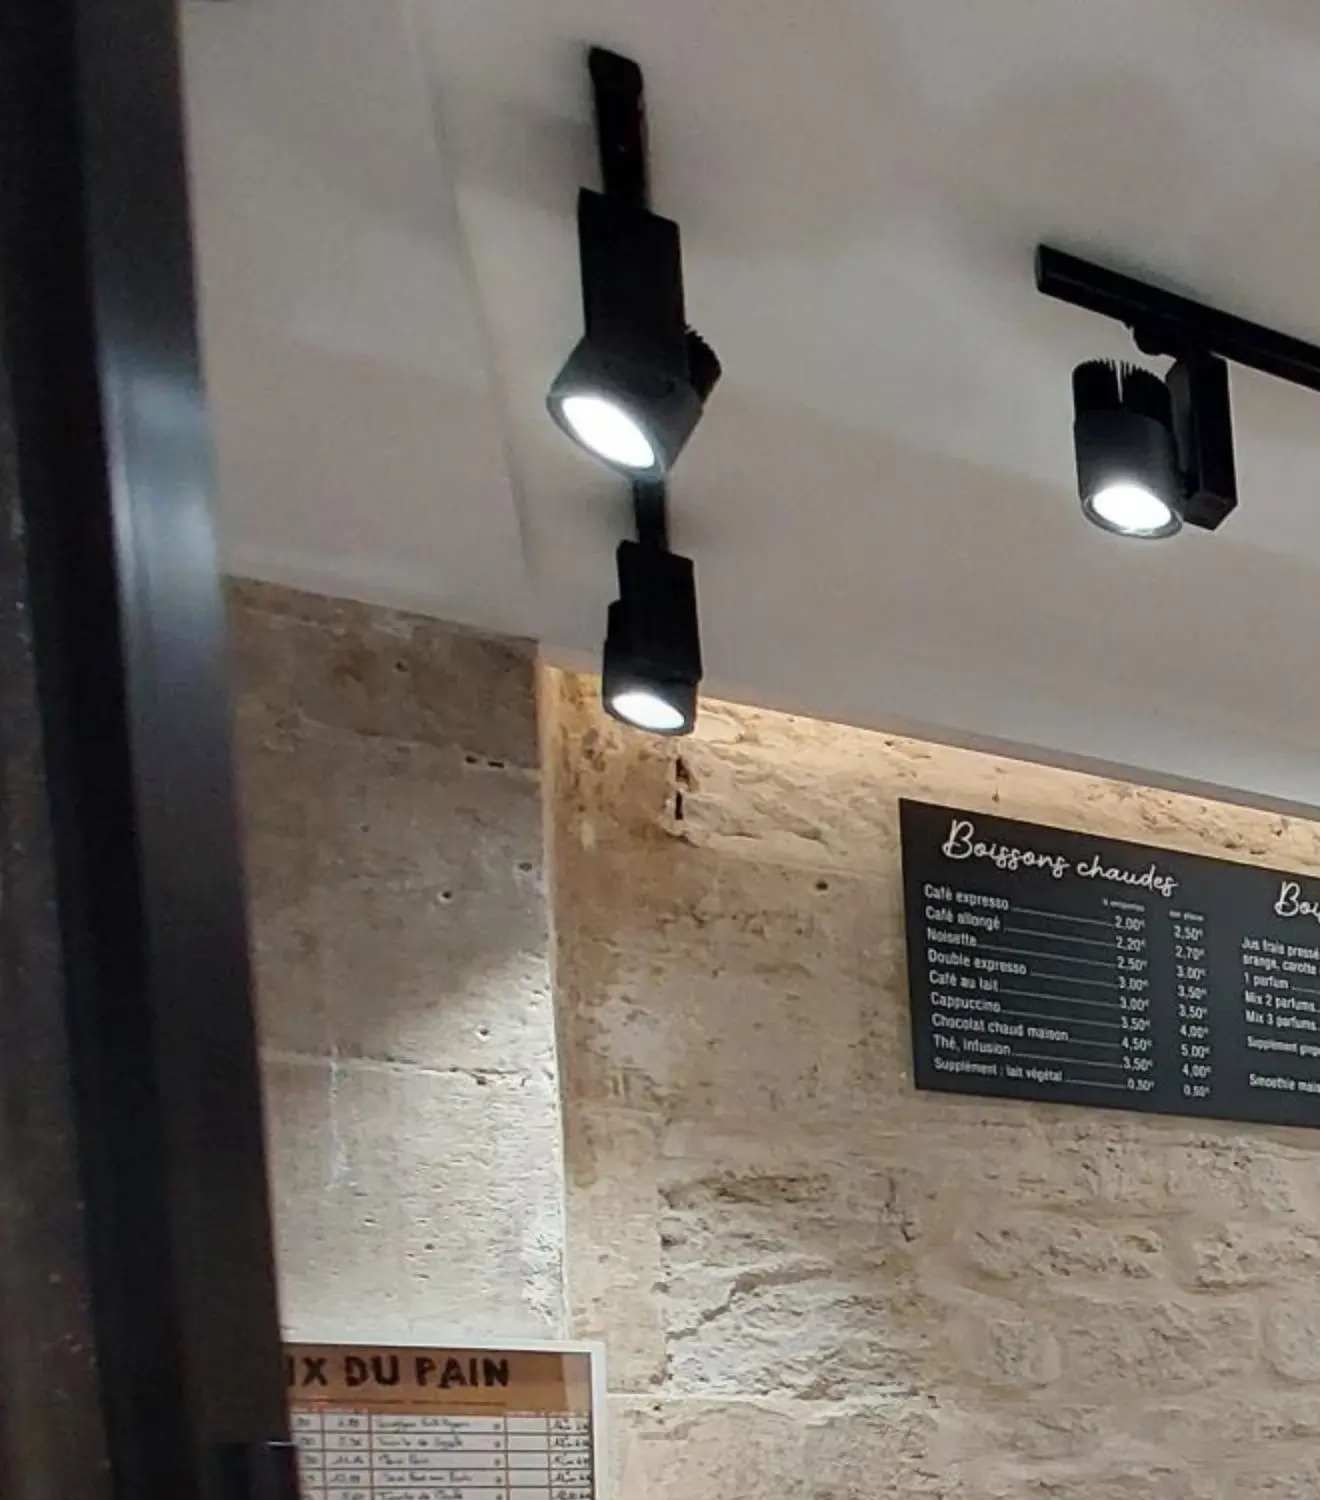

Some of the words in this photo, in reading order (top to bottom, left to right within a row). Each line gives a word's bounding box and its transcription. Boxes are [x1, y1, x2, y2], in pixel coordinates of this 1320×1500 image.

[942, 820, 1071, 877] Boissons
[1077, 855, 1178, 896] chaudes
[924, 884, 952, 900] Café
[956, 891, 1009, 910] expresso
[925, 905, 953, 922] Café
[957, 911, 1000, 931] allongé
[927, 928, 977, 946] Noisette
[927, 948, 970, 967] Double
[974, 957, 1027, 975] expresso
[929, 969, 957, 987] Café
[960, 977, 976, 989] au
[979, 977, 998, 992] lait
[1253, 974, 1289, 990] parfum
[930, 992, 1001, 1013] Cappuccino
[1245, 990, 1263, 1005] Mix
[1265, 992, 1272, 1007] 2
[1275, 996, 1316, 1013] parfums
[931, 1012, 985, 1032] Chocolat
[988, 1020, 1023, 1037] chaud
[1028, 1026, 1069, 1042] maison
[1245, 1009, 1264, 1024] Mix
[1266, 1012, 1274, 1025] 3
[1276, 1015, 1317, 1031] parfums
[963, 1037, 1012, 1056] infusion
[934, 1056, 997, 1076] Supplément
[1249, 1073, 1296, 1091] Smoothie
[286, 1356, 328, 1387] IX
[344, 1355, 400, 1387] DU
[415, 1357, 509, 1389] PAIN
